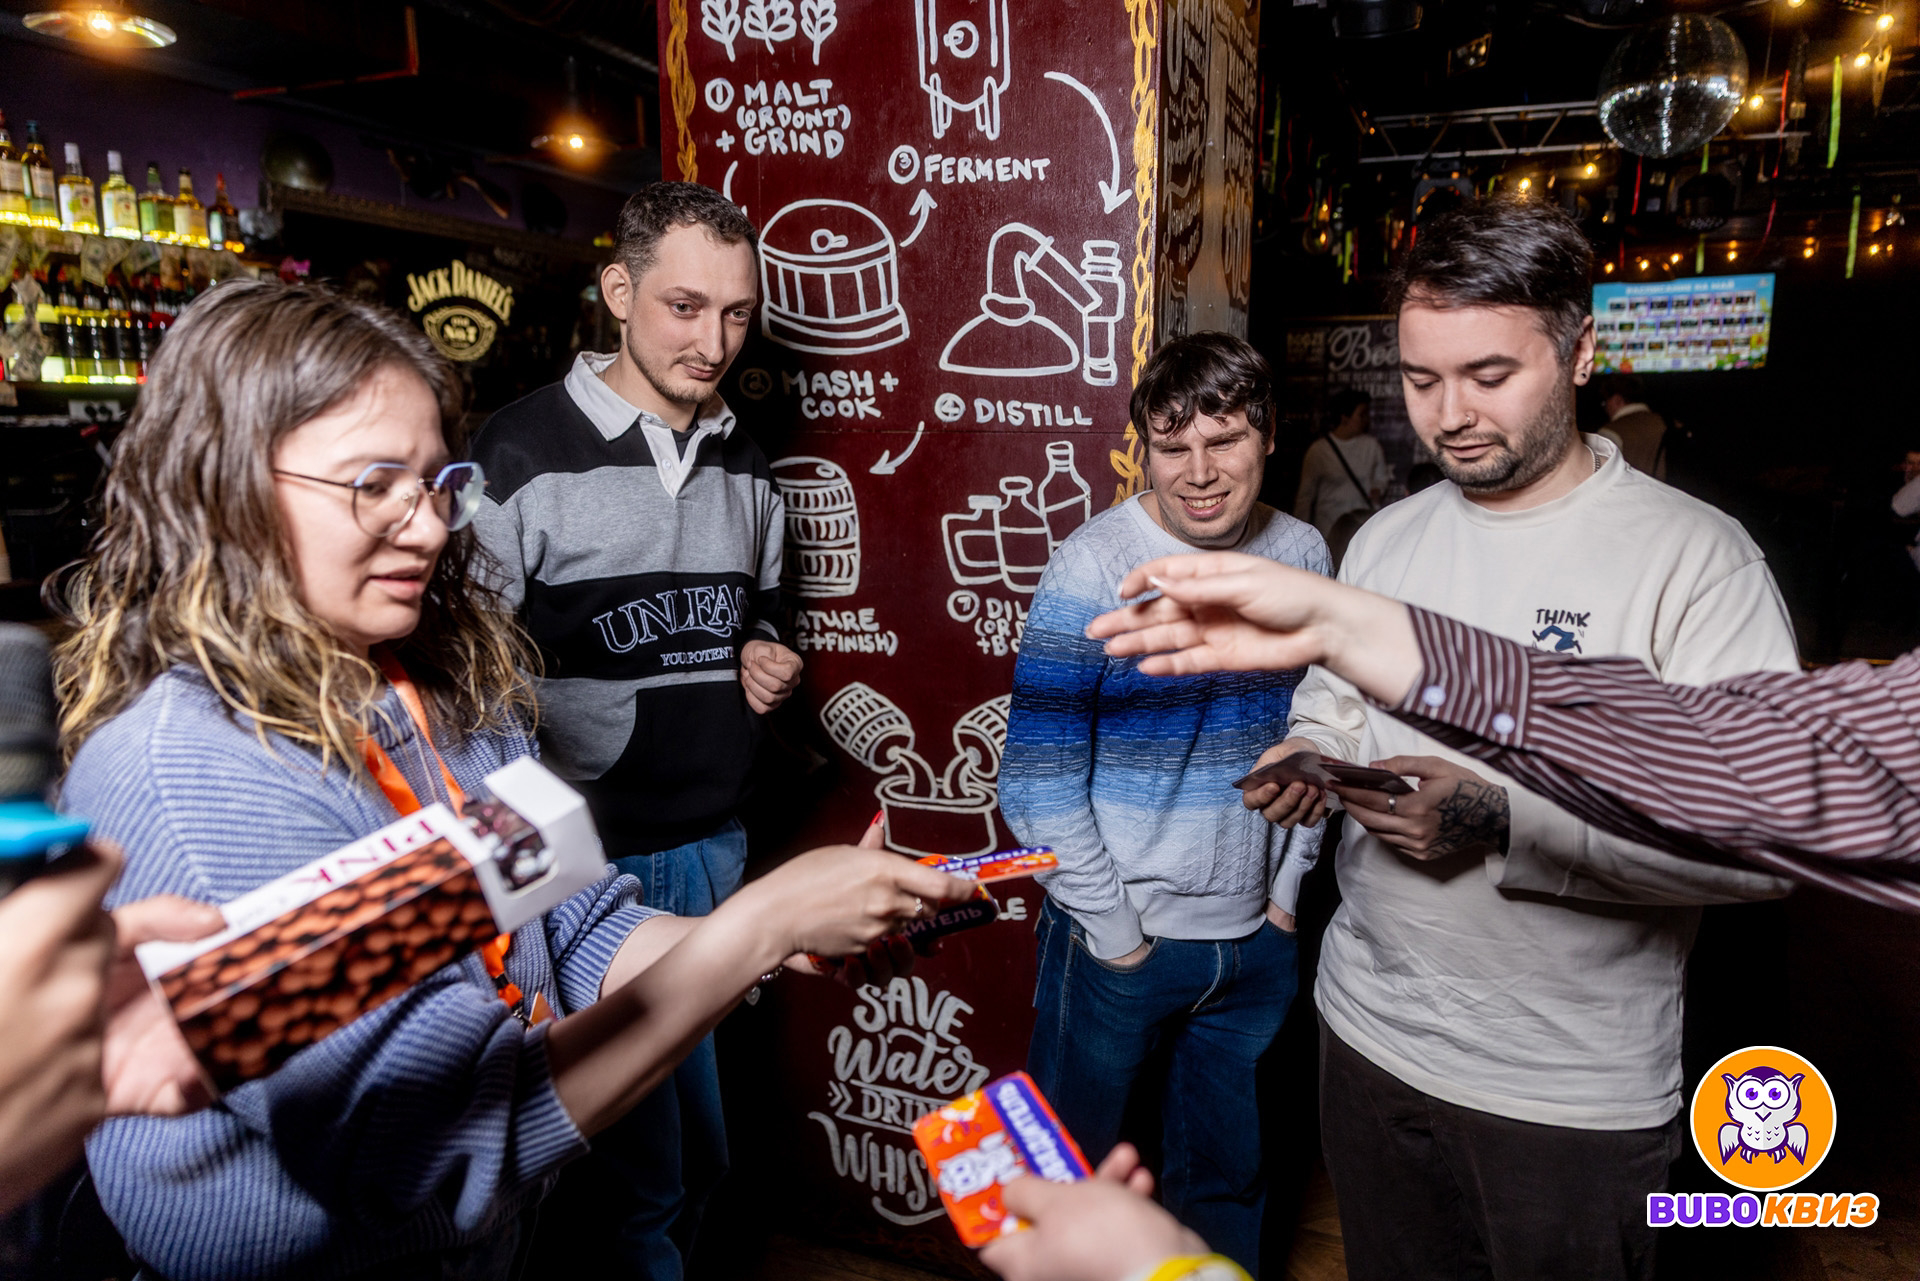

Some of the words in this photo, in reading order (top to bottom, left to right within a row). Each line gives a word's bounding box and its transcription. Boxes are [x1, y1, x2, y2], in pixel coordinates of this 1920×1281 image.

[744, 79, 833, 107] MALT
[744, 127, 844, 159] GRIND
[924, 153, 1051, 185] FERMENT
[406, 267, 451, 312] JACK
[1328, 324, 1400, 371] Bee
[781, 369, 875, 398] MASH
[801, 397, 882, 420] COOK
[973, 397, 1094, 427] DISTILL
[787, 608, 880, 632] ATURE
[985, 597, 1029, 622] DIL
[1536, 608, 1591, 628] THINK
[659, 651, 686, 667] YOU
[686, 646, 735, 664] POTENT
[291, 820, 435, 886] PINK
[852, 975, 975, 1045] SAVE
[827, 1025, 990, 1096] Water
[807, 1111, 939, 1212] WHIS
